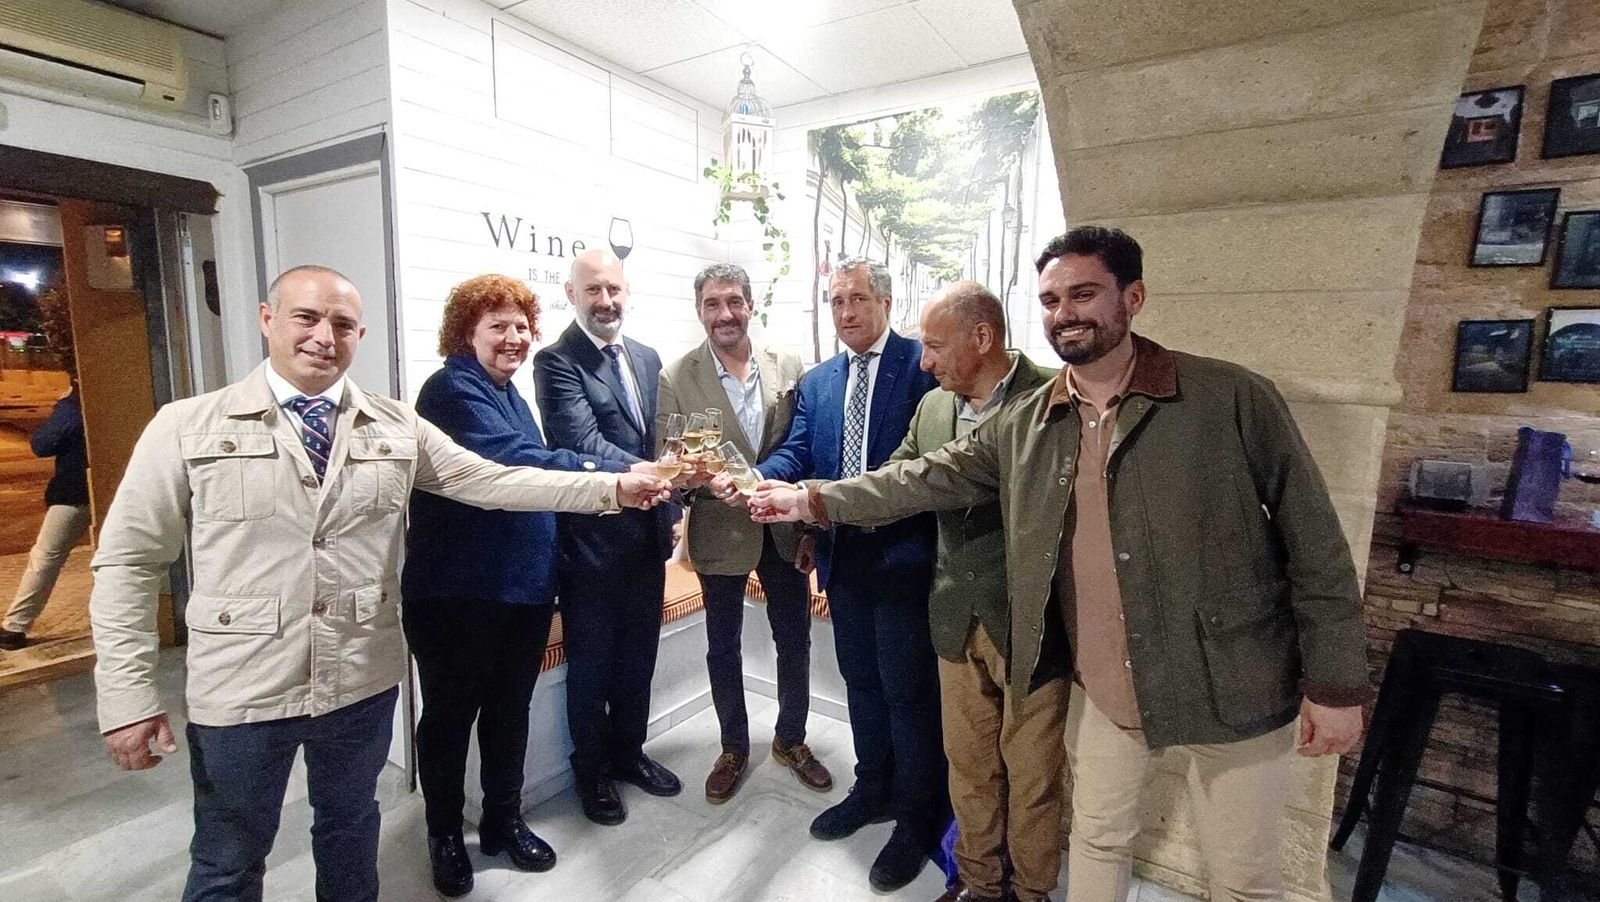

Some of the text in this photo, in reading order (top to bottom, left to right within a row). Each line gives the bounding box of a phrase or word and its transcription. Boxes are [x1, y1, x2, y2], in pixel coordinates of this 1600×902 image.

[481, 212, 586, 257] Wine
[528, 268, 560, 284] IS THE
